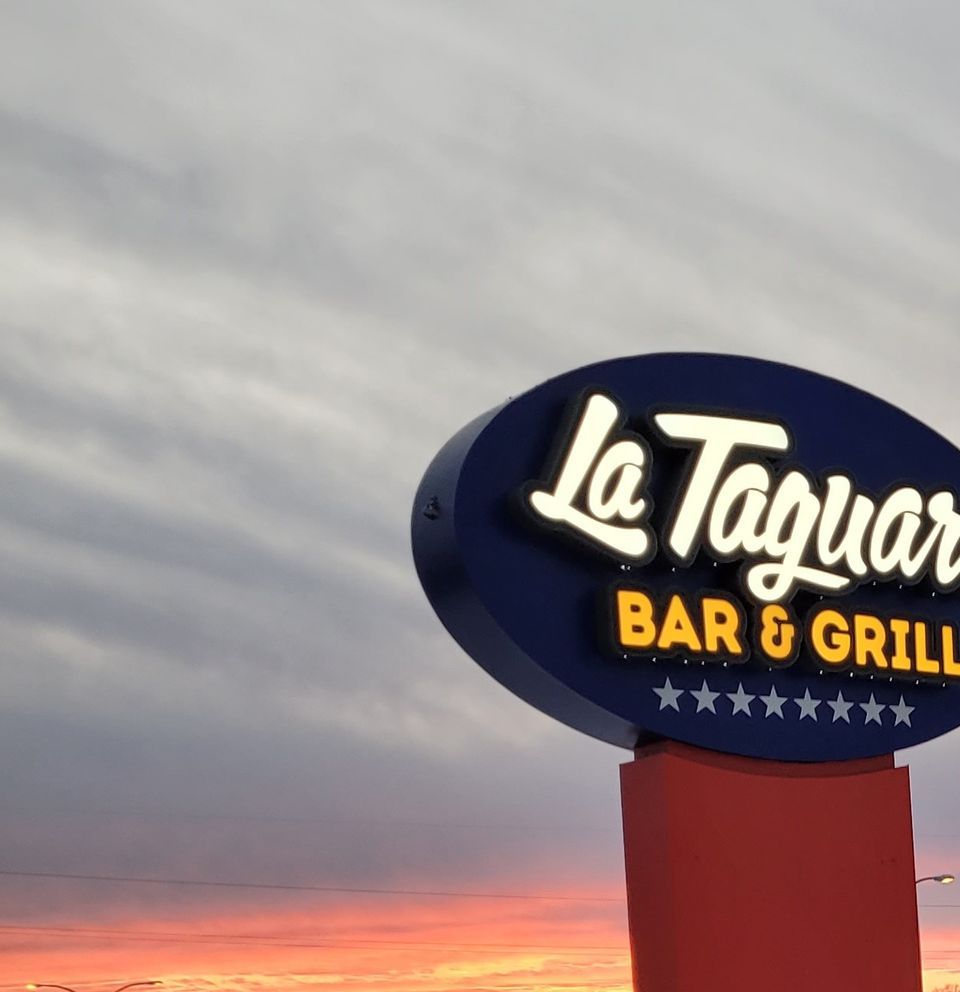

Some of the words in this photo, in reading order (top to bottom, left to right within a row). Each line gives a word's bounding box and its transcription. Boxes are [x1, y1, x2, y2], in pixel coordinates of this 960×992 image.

[530, 393, 649, 557] La
[616, 589, 742, 655] BAR
[760, 603, 795, 660] &
